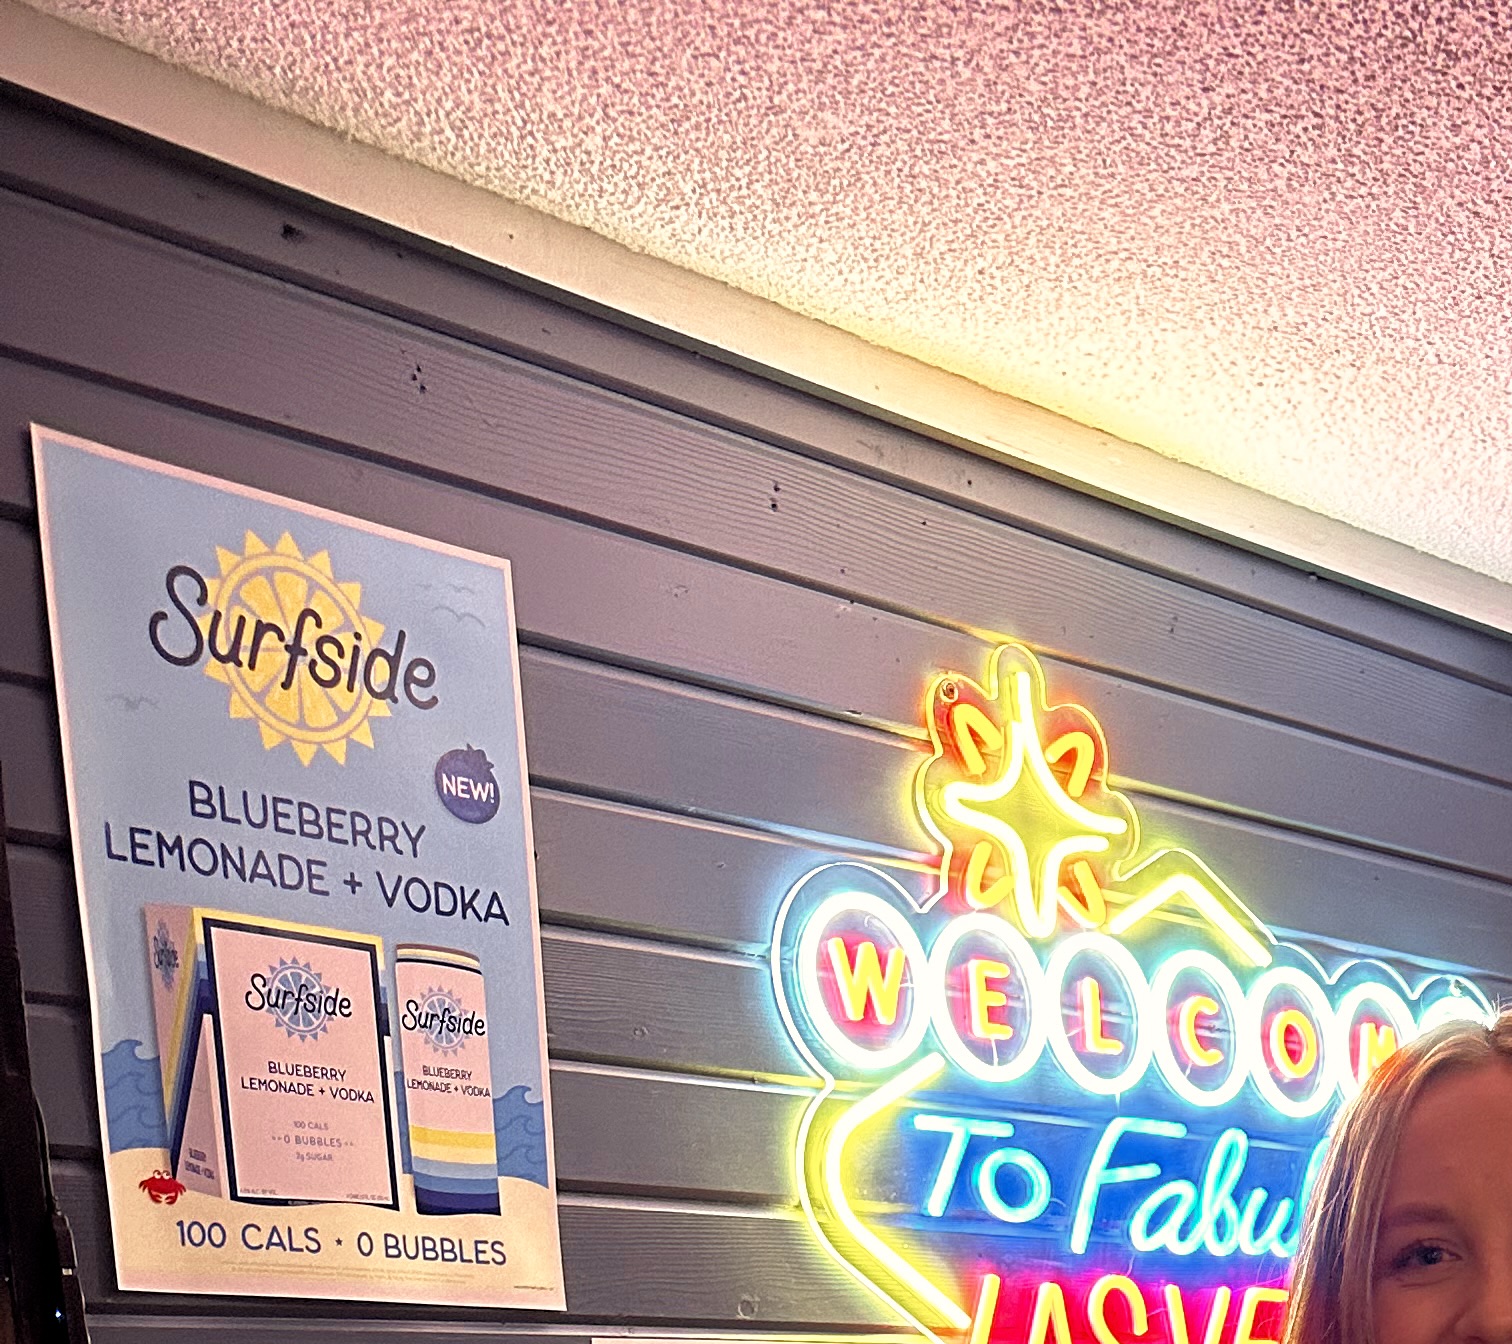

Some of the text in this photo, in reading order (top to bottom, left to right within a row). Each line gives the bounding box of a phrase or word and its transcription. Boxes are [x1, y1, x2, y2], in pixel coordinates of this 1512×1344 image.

[149, 564, 440, 712] Surfside
[441, 773, 496, 805] NEW!
[188, 780, 428, 860] BLUEBERRY
[104, 822, 330, 898] LEMONADE
[376, 869, 511, 928] VODKA
[245, 972, 353, 1019] Surfside
[826, 932, 1400, 1084] WELCOM
[402, 998, 486, 1038] Surfside
[241, 1076, 375, 1104] LEMONADE VODKA
[267, 1060, 347, 1082] BLUEBERRY
[406, 1079, 491, 1098] LEMONADE VODKA
[422, 1065, 472, 1082] BLUEBERRY
[294, 1135, 342, 1149] BUBBLES
[913, 1113, 1050, 1224] To
[176, 1221, 227, 1250] 100
[241, 1223, 322, 1255] CALS
[384, 1233, 507, 1266] BUBBLES
